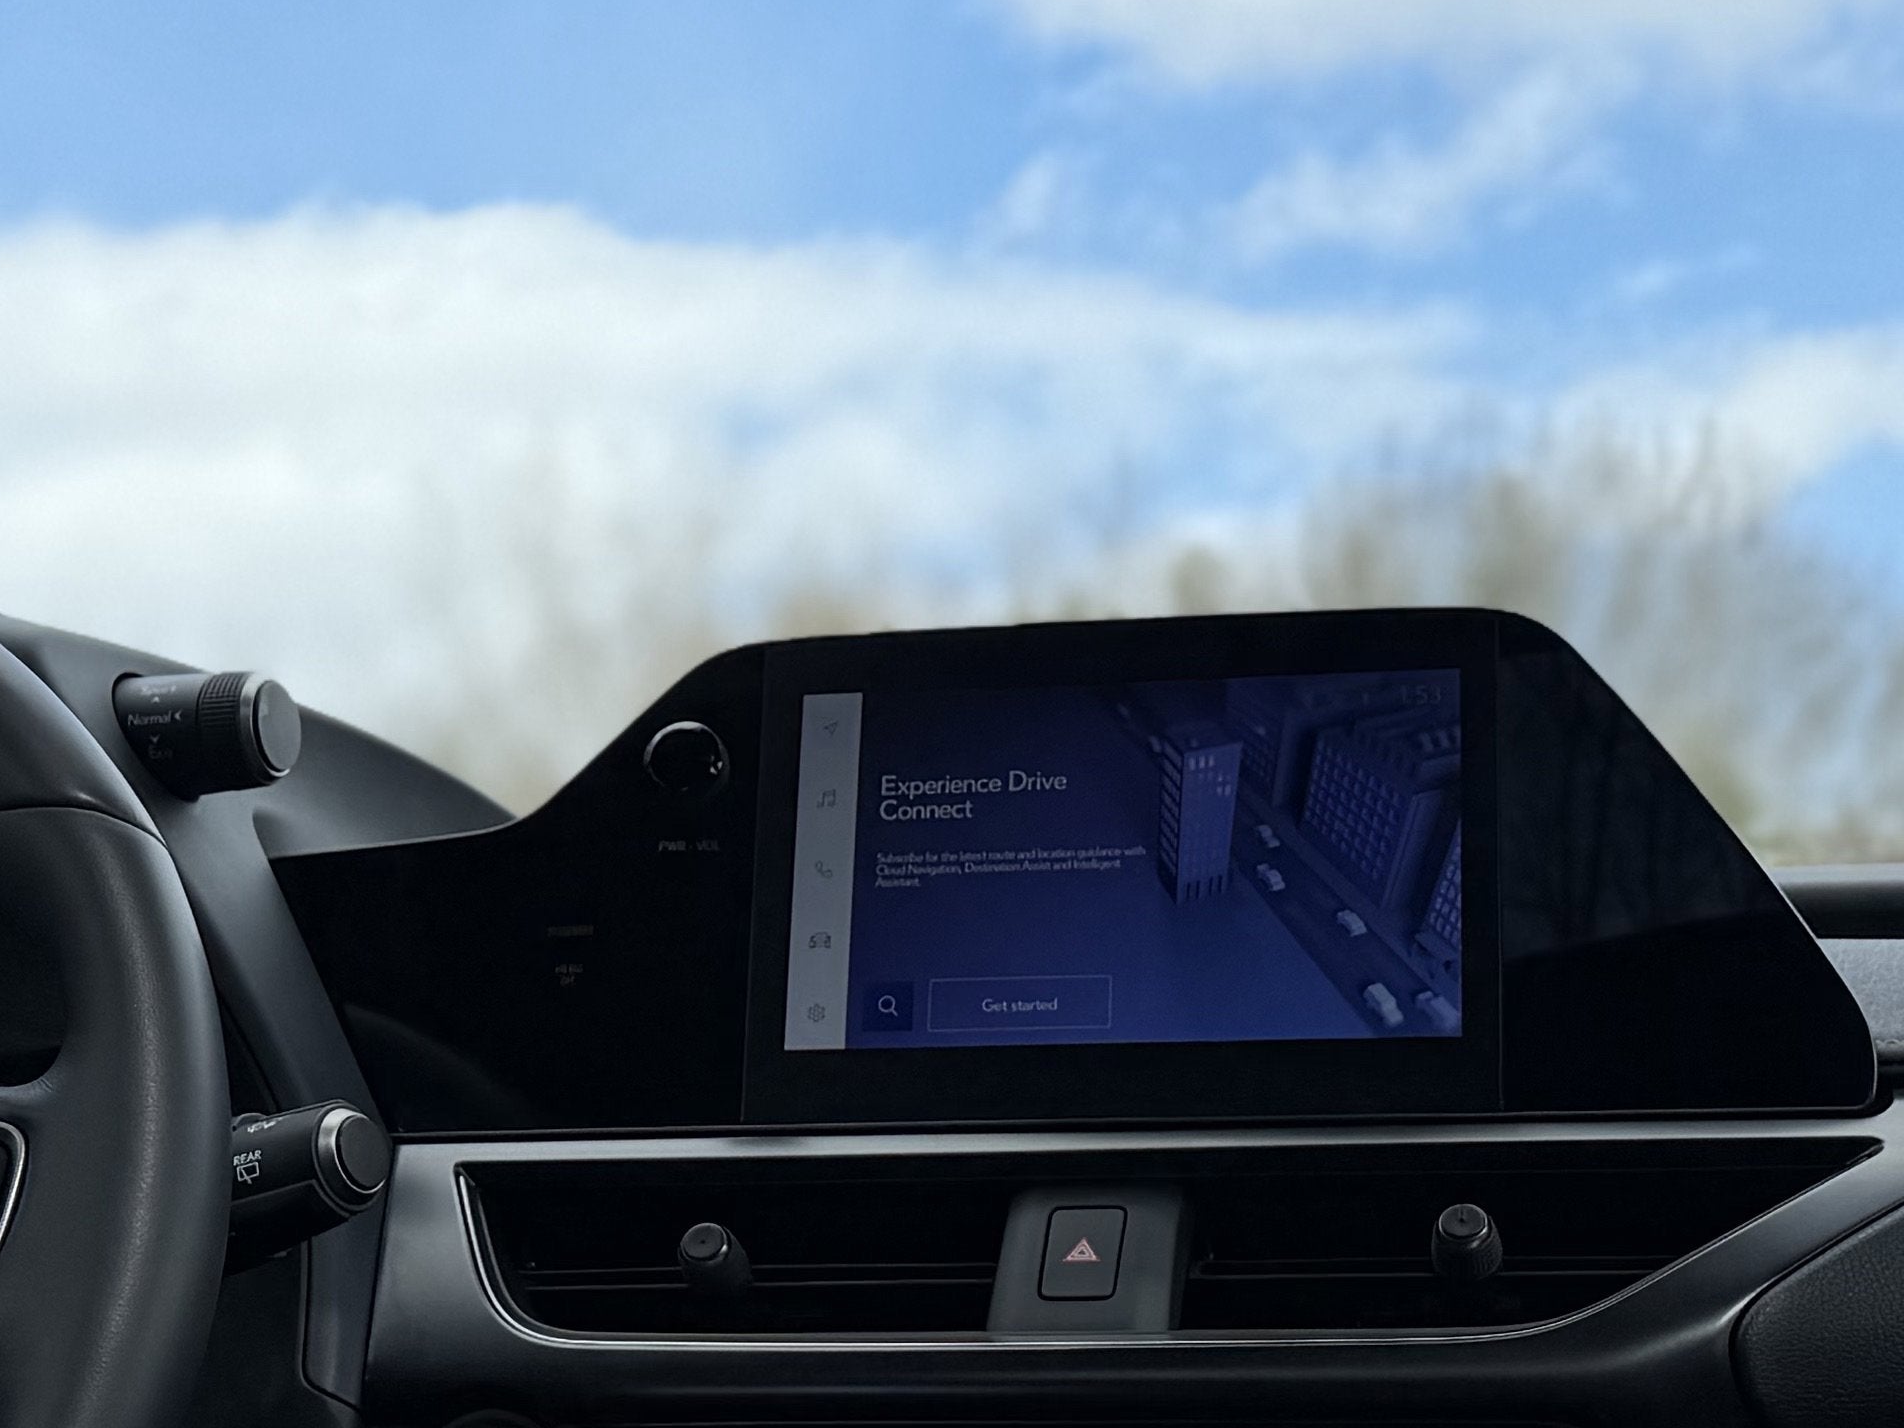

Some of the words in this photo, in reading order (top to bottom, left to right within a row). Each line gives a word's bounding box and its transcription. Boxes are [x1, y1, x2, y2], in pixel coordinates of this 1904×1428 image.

[127, 711, 171, 727] Normal
[880, 775, 1002, 800] Experience
[1008, 770, 1068, 792] Drive
[879, 799, 974, 821] Connect
[981, 998, 1008, 1013] Get
[1010, 997, 1058, 1011] started
[233, 1149, 262, 1167] REAR
